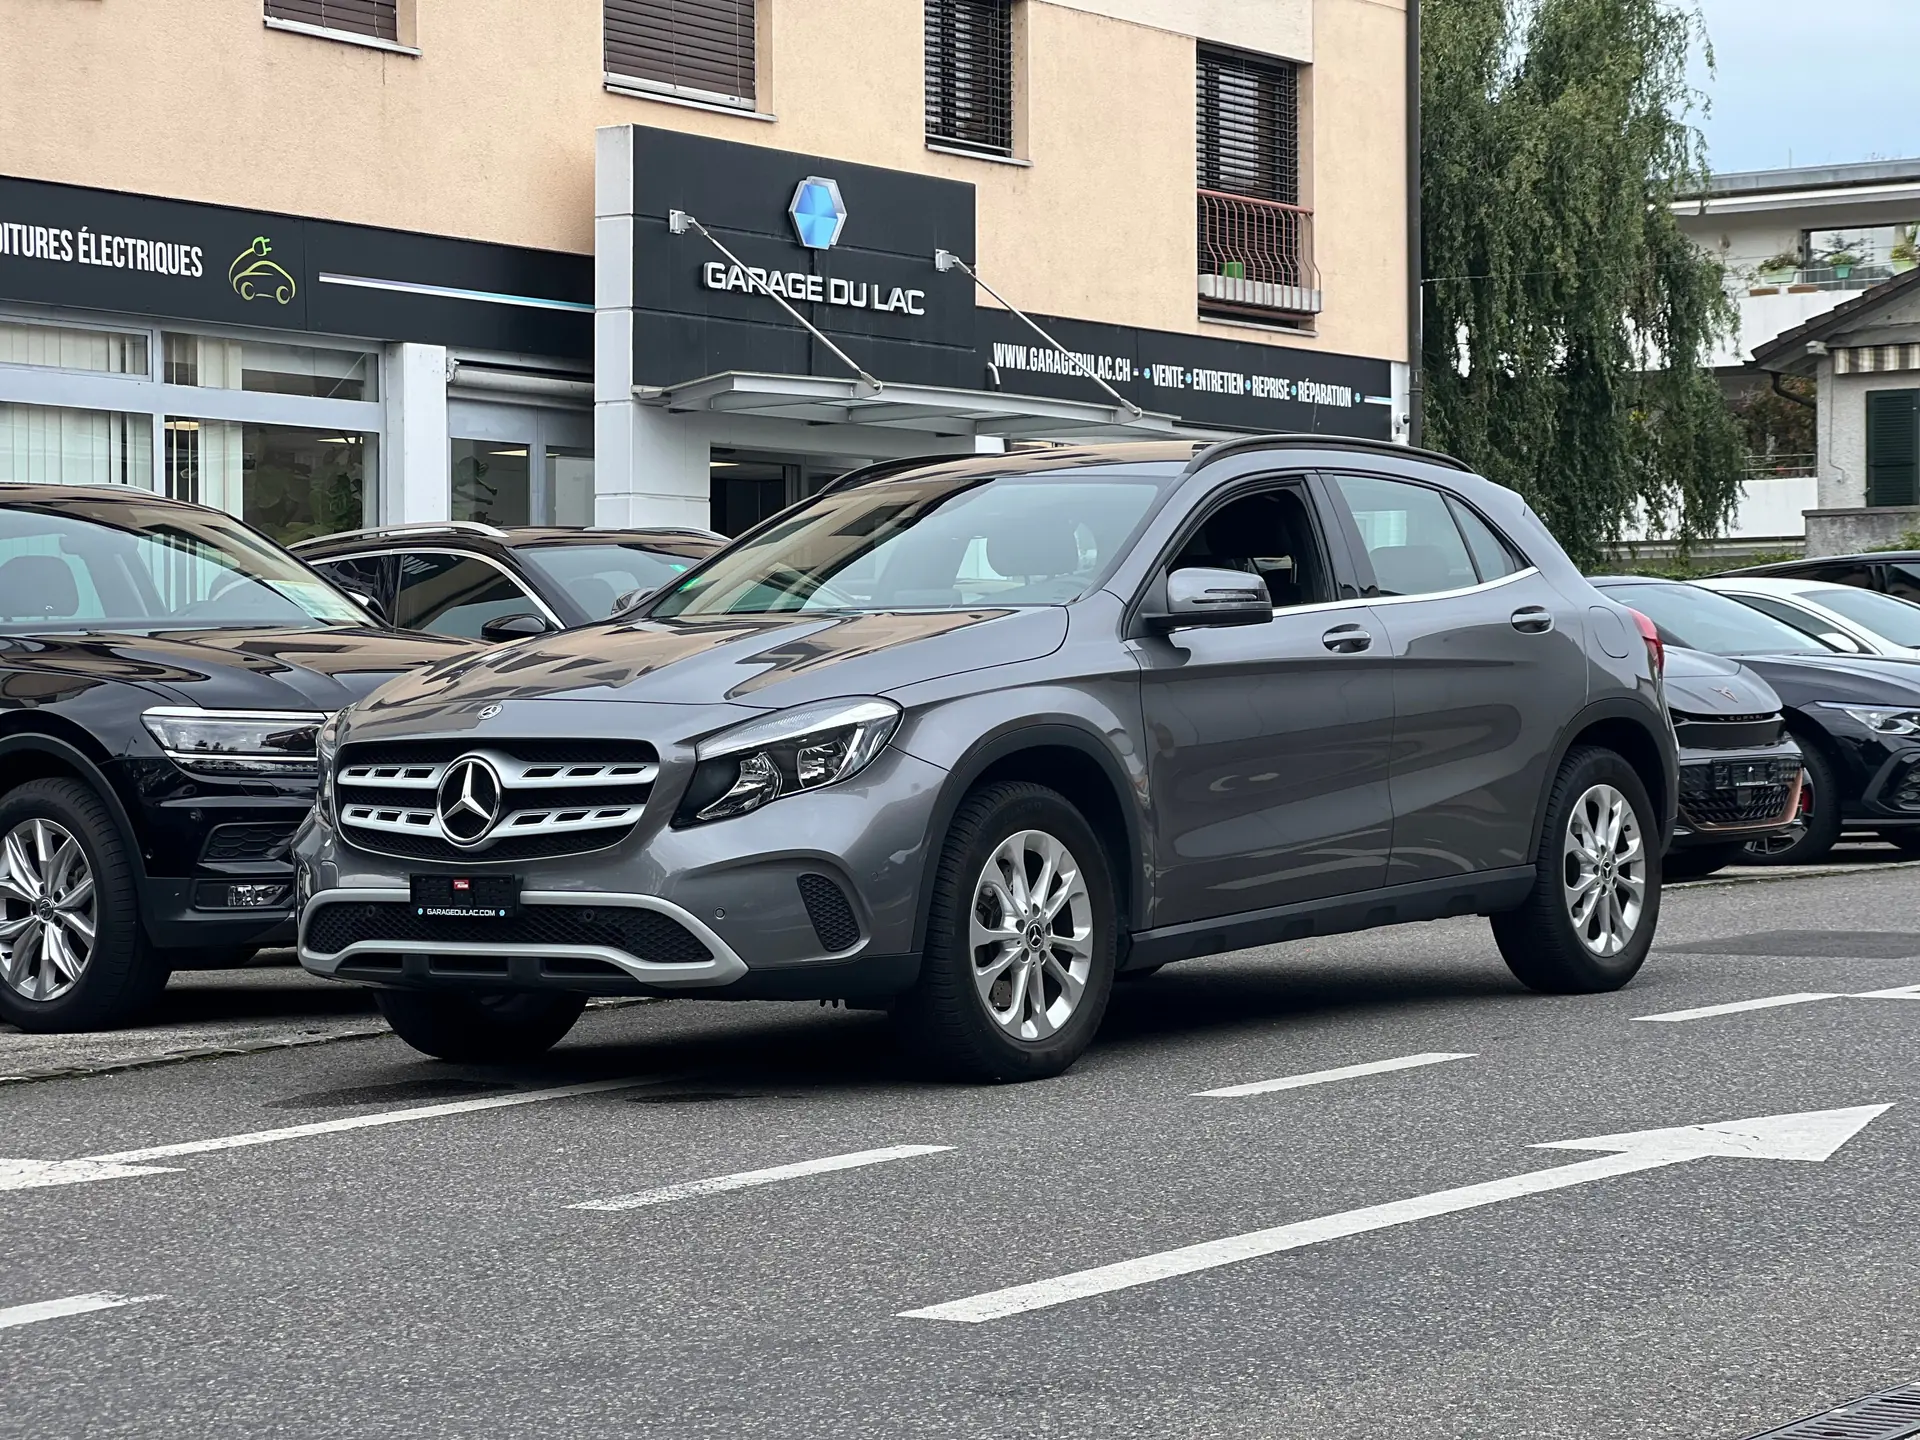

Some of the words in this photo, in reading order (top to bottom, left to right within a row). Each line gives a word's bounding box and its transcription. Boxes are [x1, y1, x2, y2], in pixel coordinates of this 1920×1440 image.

[0, 222, 73, 262] ITURES
[78, 226, 203, 278] ÉLECTRIQUES
[704, 262, 823, 301] GARAGE
[828, 278, 867, 307] DU
[870, 284, 925, 316] LAC
[993, 342, 1131, 382] WWW.GARAGEDULAC.CH
[1152, 364, 1184, 388] VENTE
[1193, 368, 1244, 395] ENTRETIEN
[1252, 375, 1290, 400] REPRISE
[1298, 378, 1352, 407] RÉPARATION
[426, 908, 496, 917] GARAGEDULAC.COM
